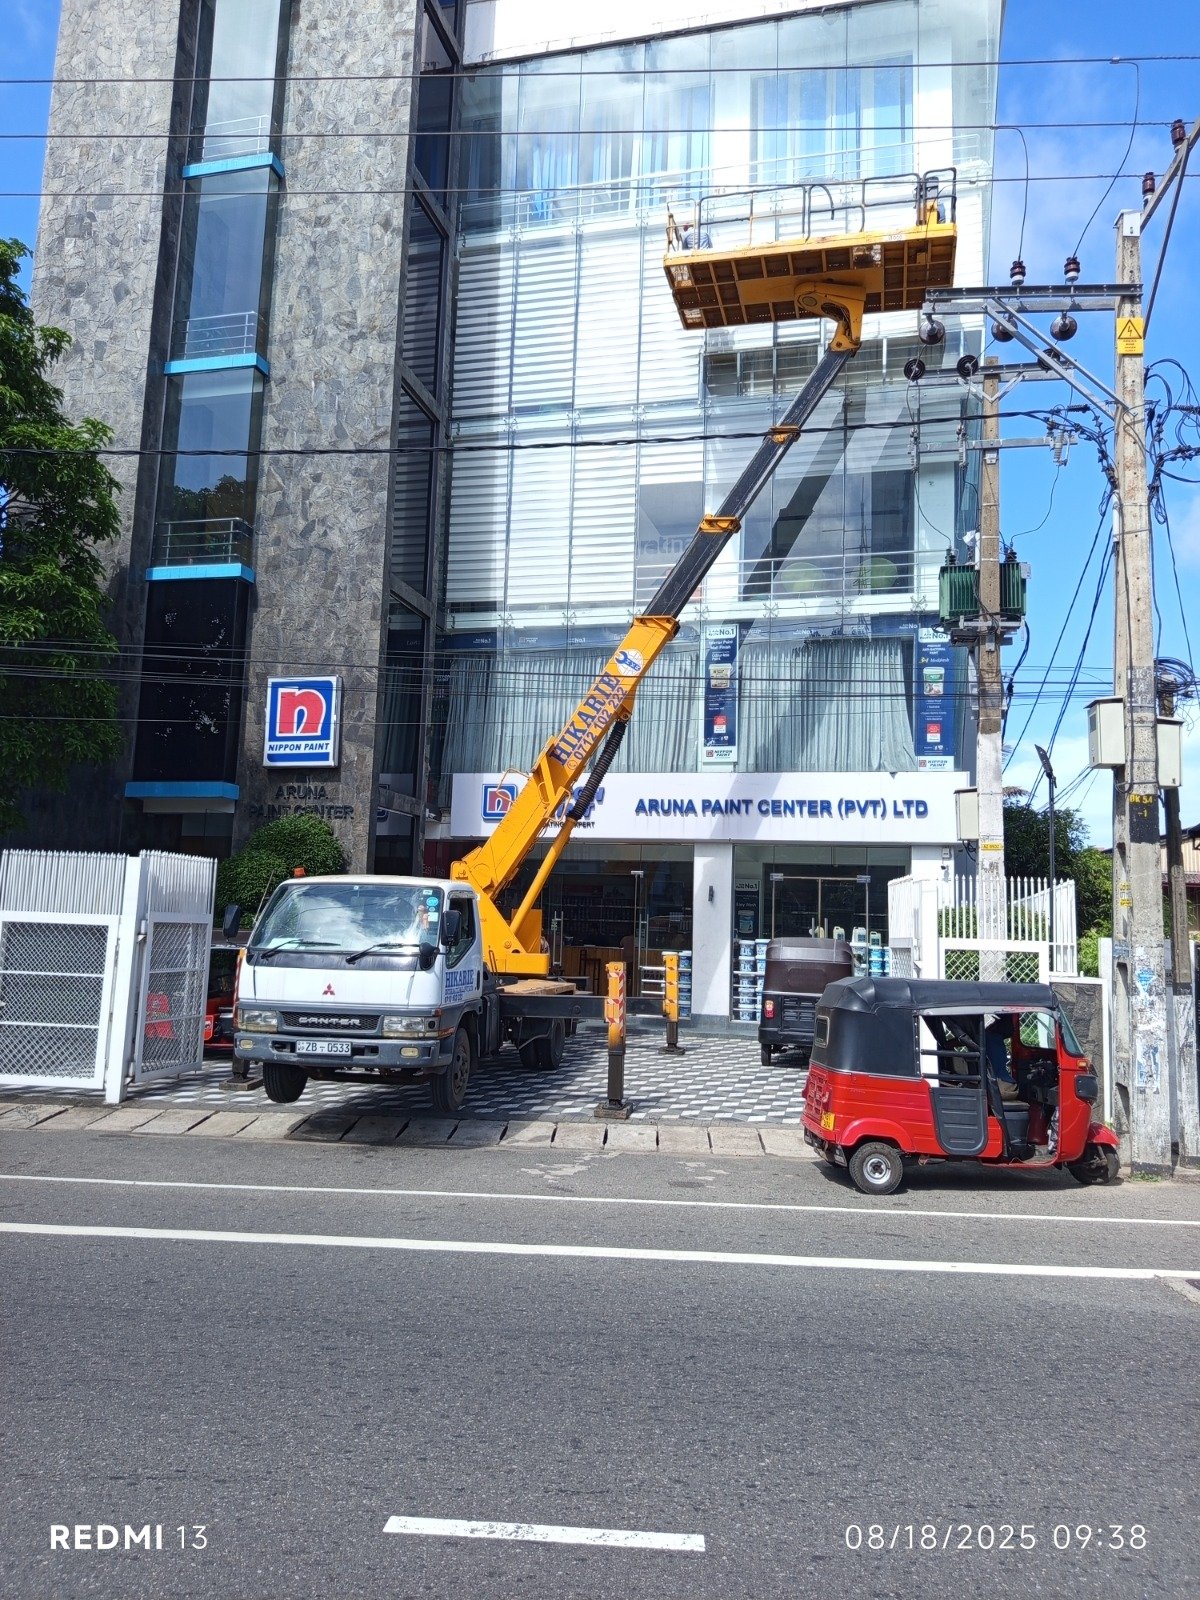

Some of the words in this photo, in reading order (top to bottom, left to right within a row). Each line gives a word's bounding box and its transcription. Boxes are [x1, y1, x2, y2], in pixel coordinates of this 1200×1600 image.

[549, 671, 621, 766] HIKARIE
[573, 731, 598, 760] 0712
[593, 709, 612, 730] 102
[608, 686, 628, 709] 222
[268, 743, 302, 751] NIPPON
[304, 742, 330, 751] PAINT
[275, 785, 329, 800] ARUNA
[248, 804, 291, 818] PAINT
[293, 804, 355, 819] CENTER
[634, 798, 698, 816] ARUNA
[701, 798, 753, 817] PAINT
[757, 799, 833, 818] CENTER
[837, 798, 887, 820] (PVT)
[893, 799, 929, 818] LTD
[574, 821, 595, 829] XPERT
[445, 969, 475, 988] HIKARIE
[299, 1016, 362, 1026] CANTER
[327, 1042, 350, 1053] 0533
